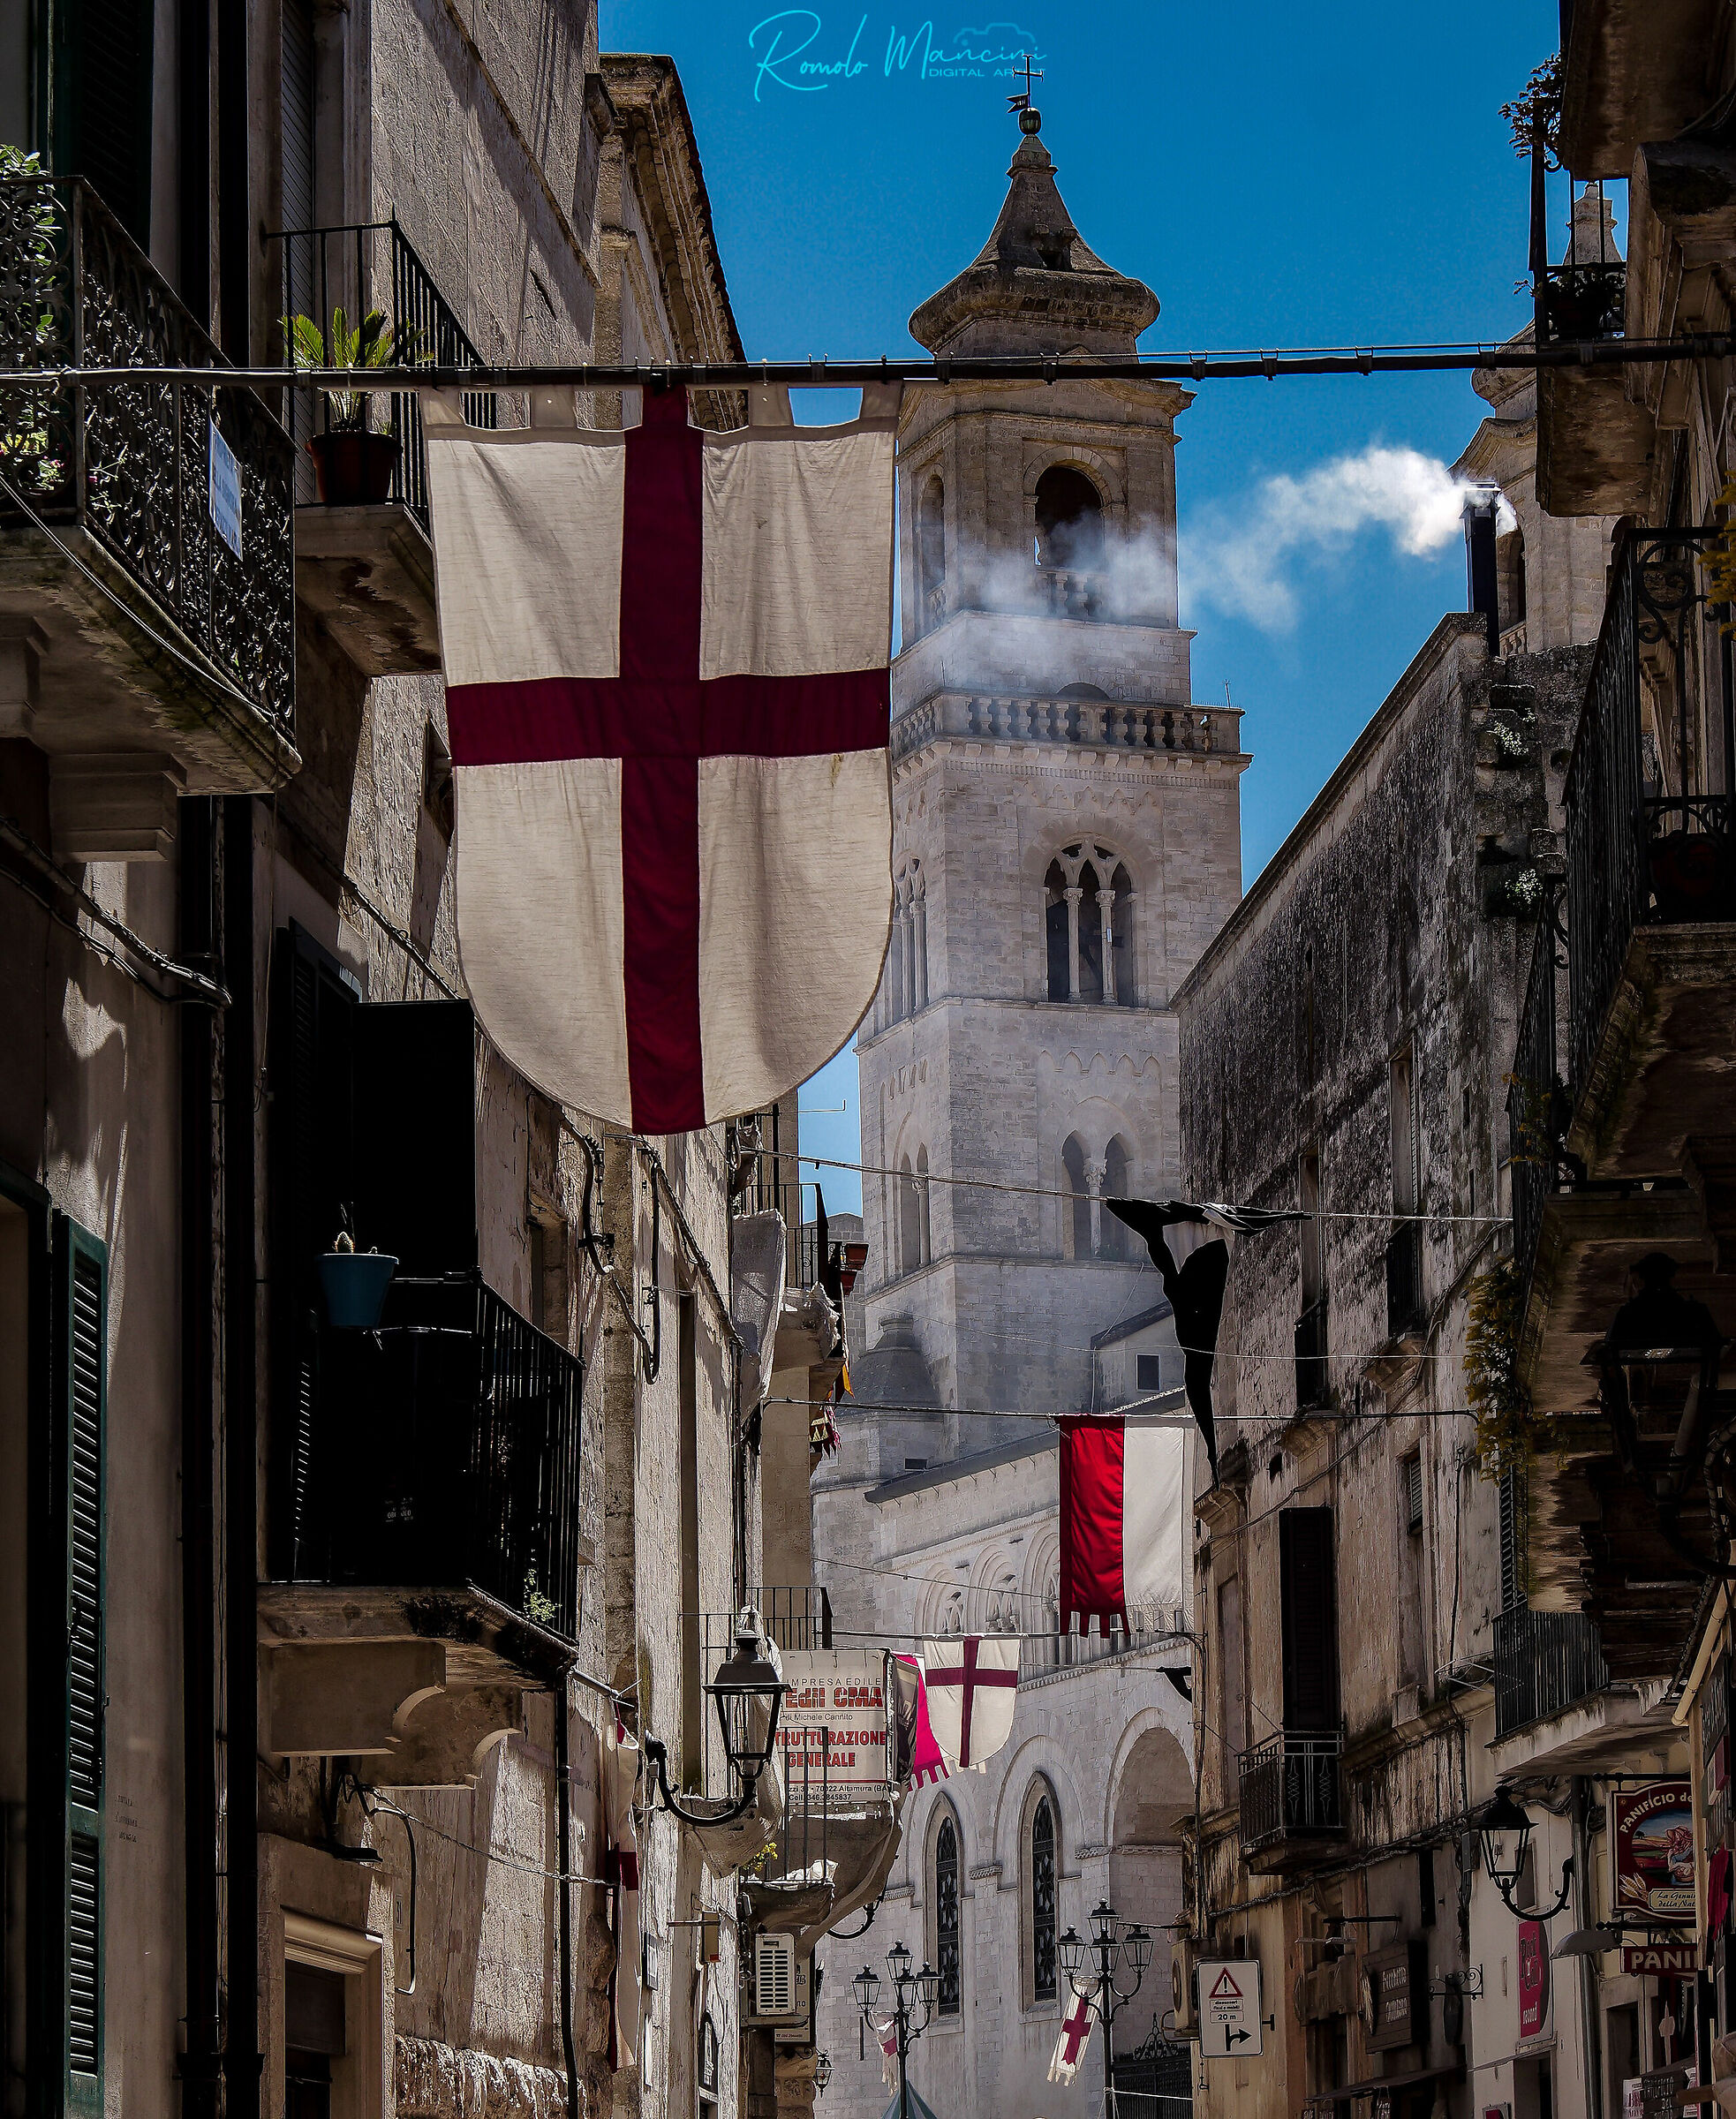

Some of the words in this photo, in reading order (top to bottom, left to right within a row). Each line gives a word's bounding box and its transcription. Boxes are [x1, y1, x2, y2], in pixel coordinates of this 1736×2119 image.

[833, 1686, 884, 1708] CMA
[788, 1752, 855, 1768] GENERALE
[1619, 1793, 1676, 1834] PANIFICIO
